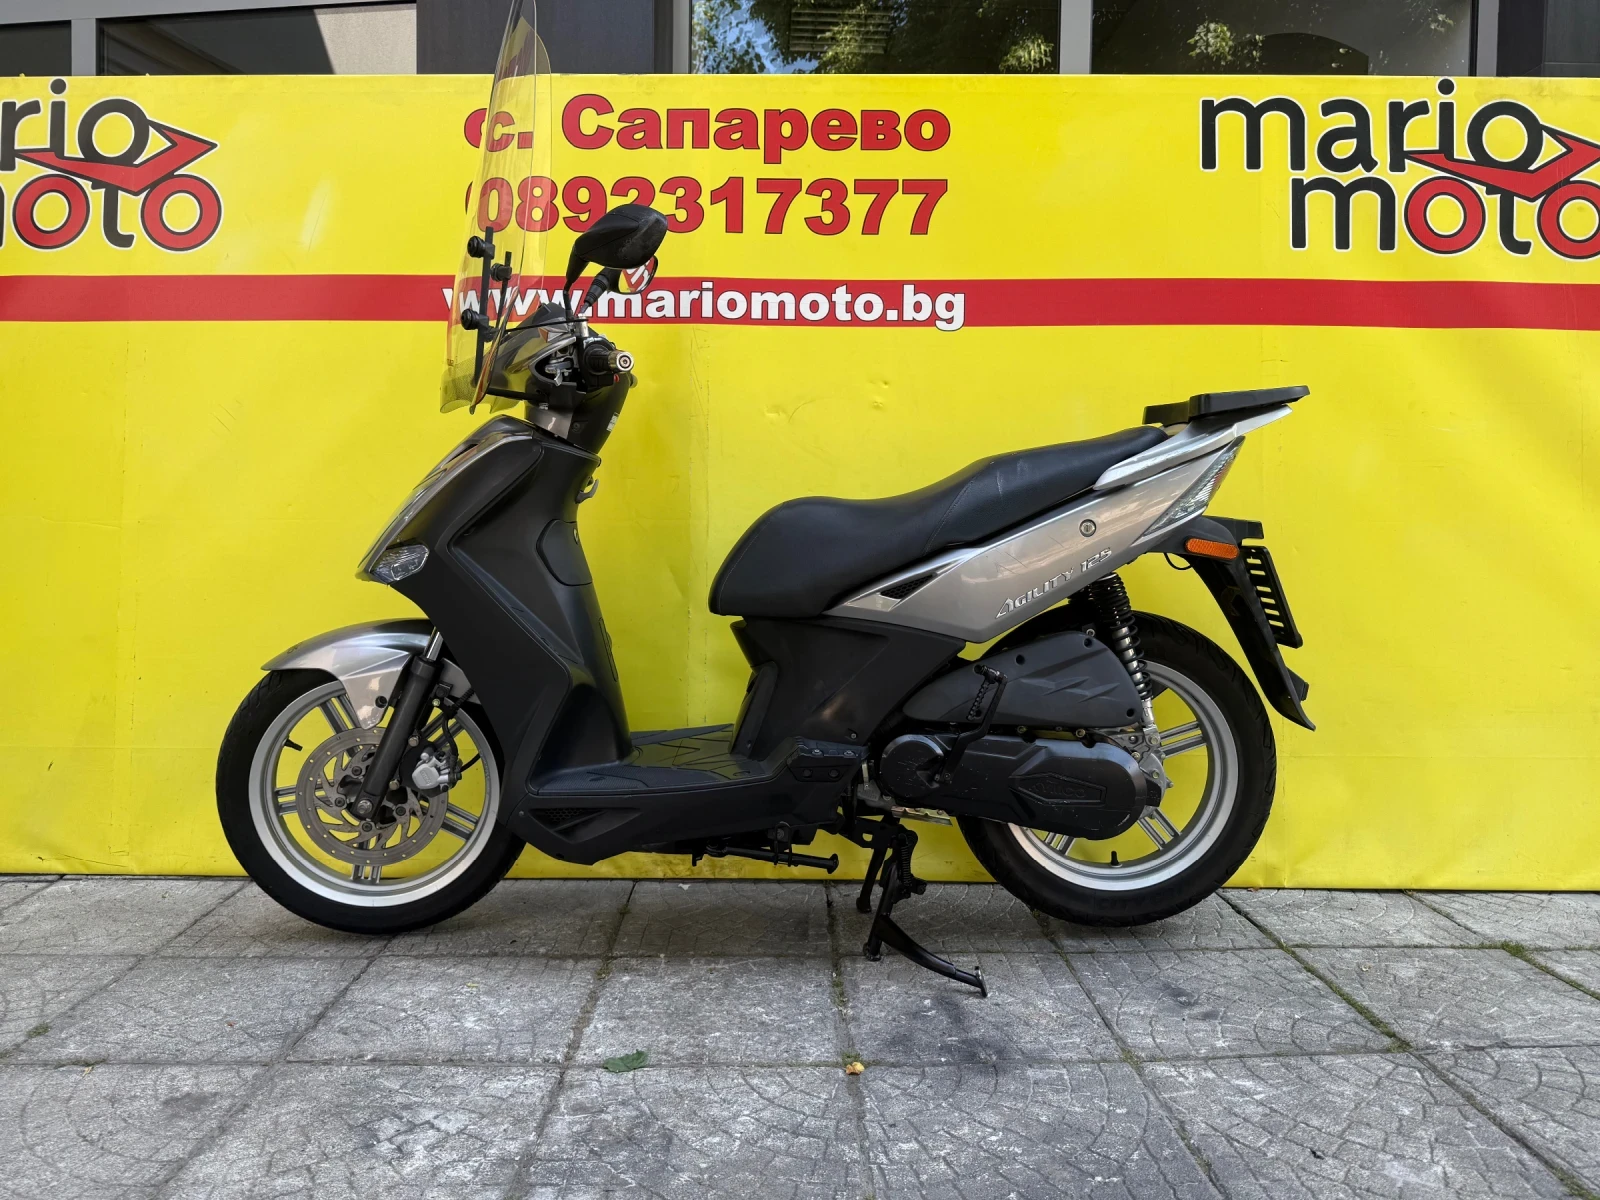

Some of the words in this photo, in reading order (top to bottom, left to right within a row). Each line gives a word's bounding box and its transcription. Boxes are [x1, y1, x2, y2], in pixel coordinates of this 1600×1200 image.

[561, 93, 951, 164] Сапарево
[1201, 78, 1544, 173] mario
[0, 173, 222, 252] oto
[1291, 175, 1600, 260] moto
[442, 280, 965, 331] www.mariomoto.bg
[996, 566, 1074, 619] AGILITY
[1080, 547, 1112, 573] 125
